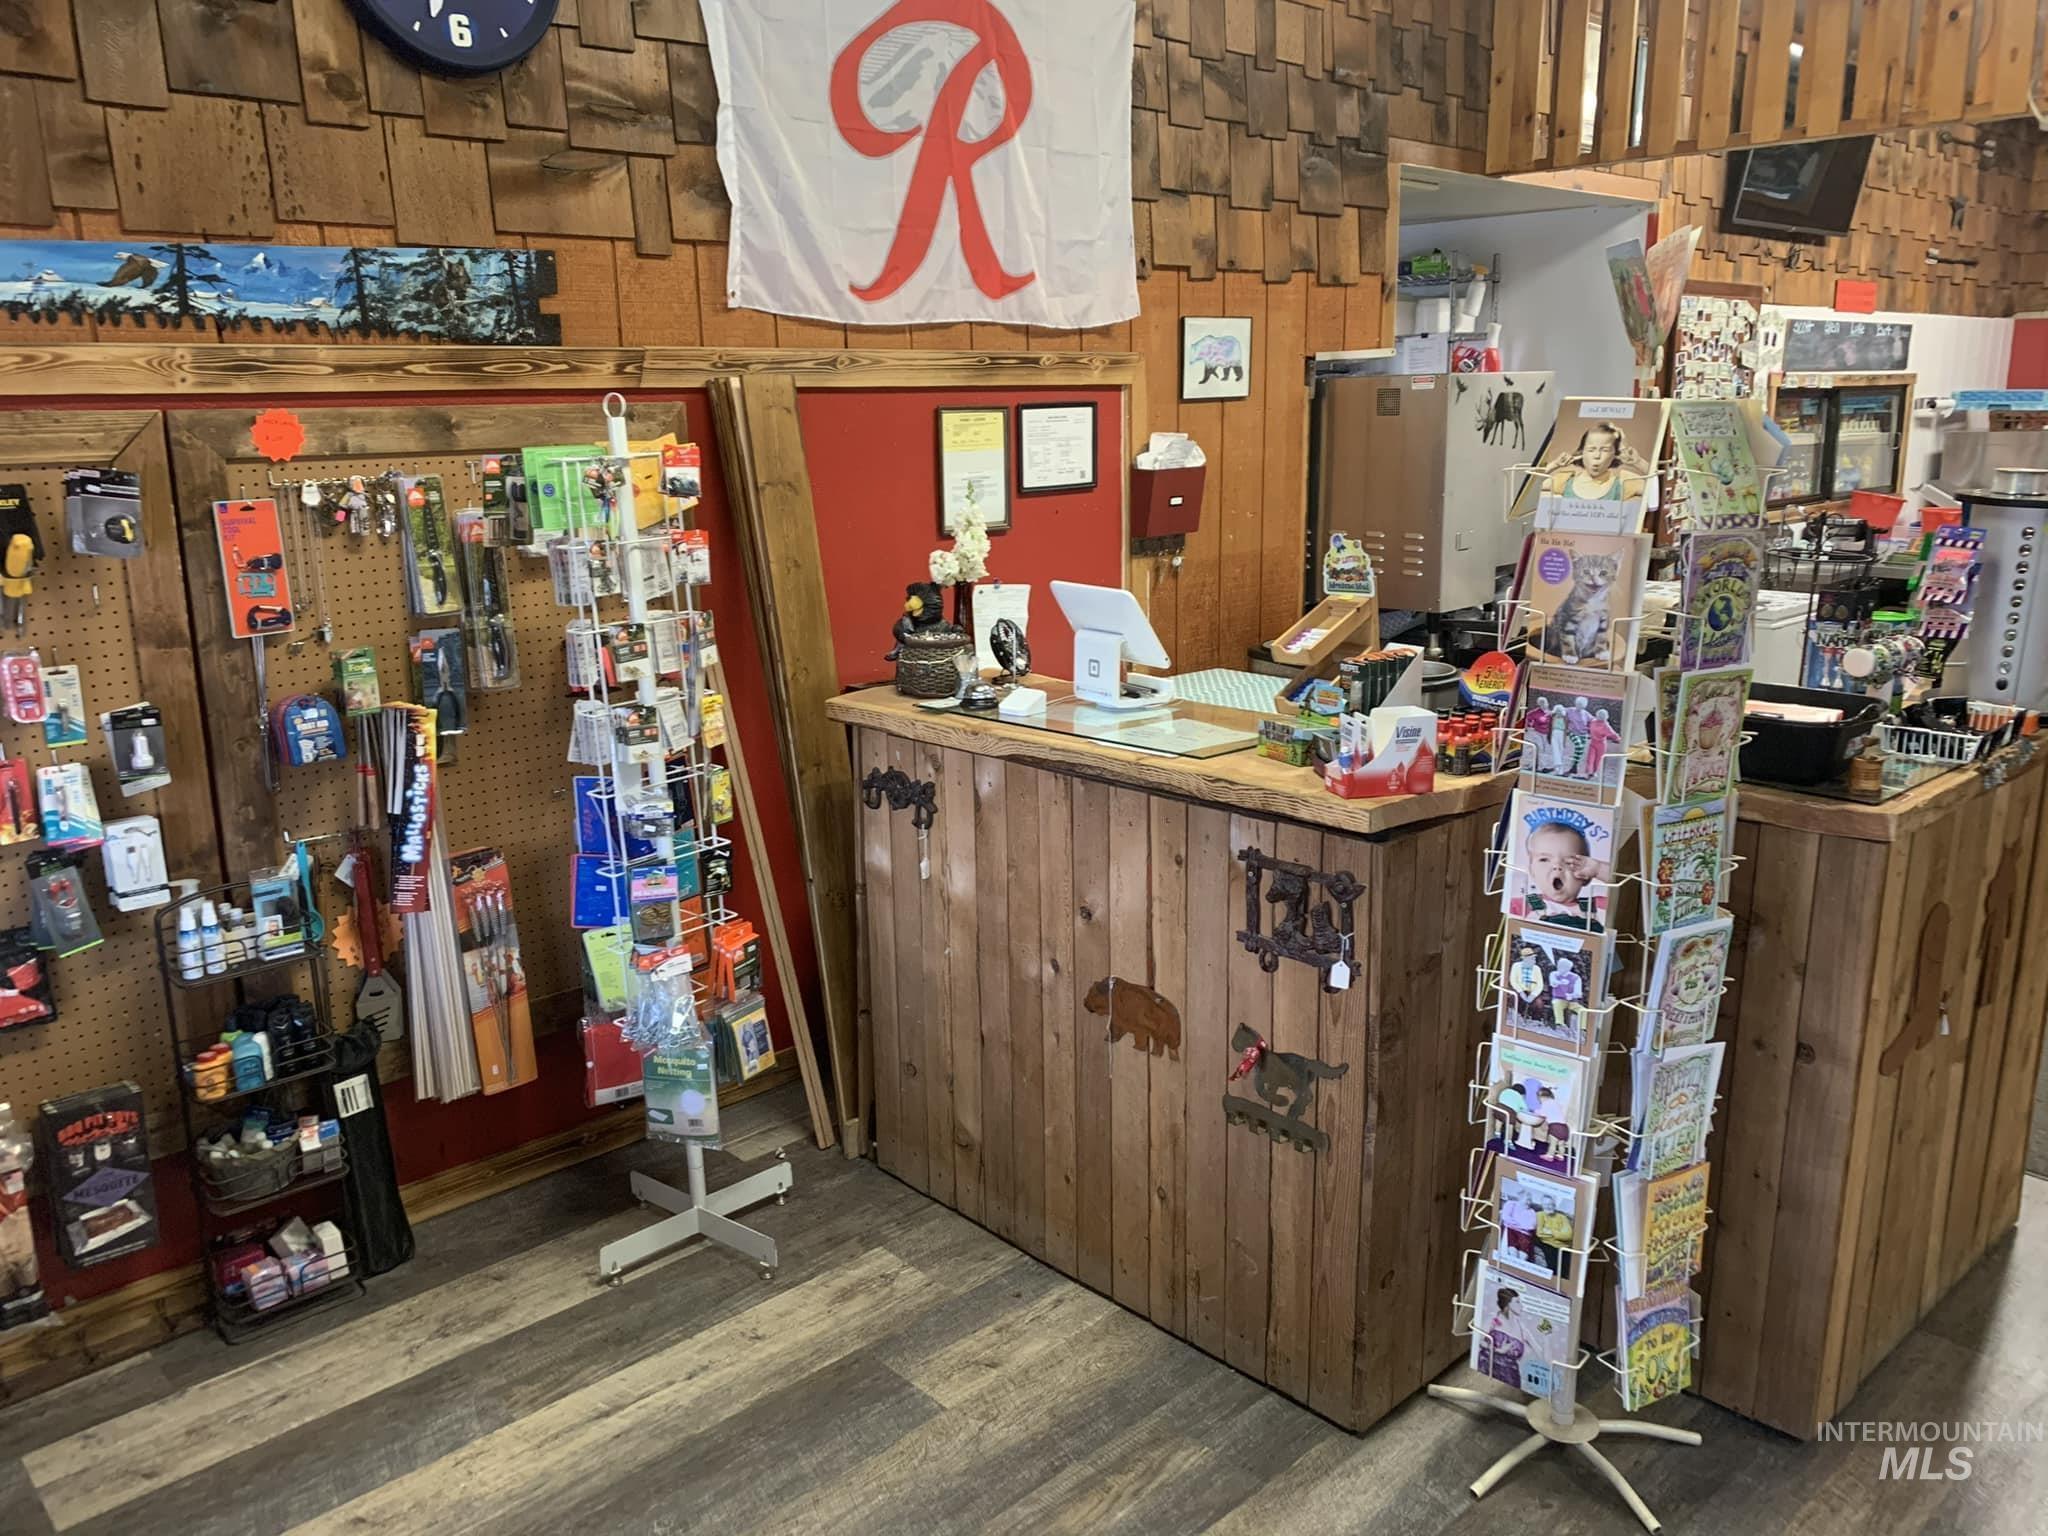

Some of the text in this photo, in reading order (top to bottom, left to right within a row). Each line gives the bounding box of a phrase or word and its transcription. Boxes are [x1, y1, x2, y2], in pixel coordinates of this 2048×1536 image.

[449, 14, 473, 47] 6
[830, 0, 1035, 301] R
[1484, 666, 1493, 679] 5
[1396, 725, 1422, 738] Visine
